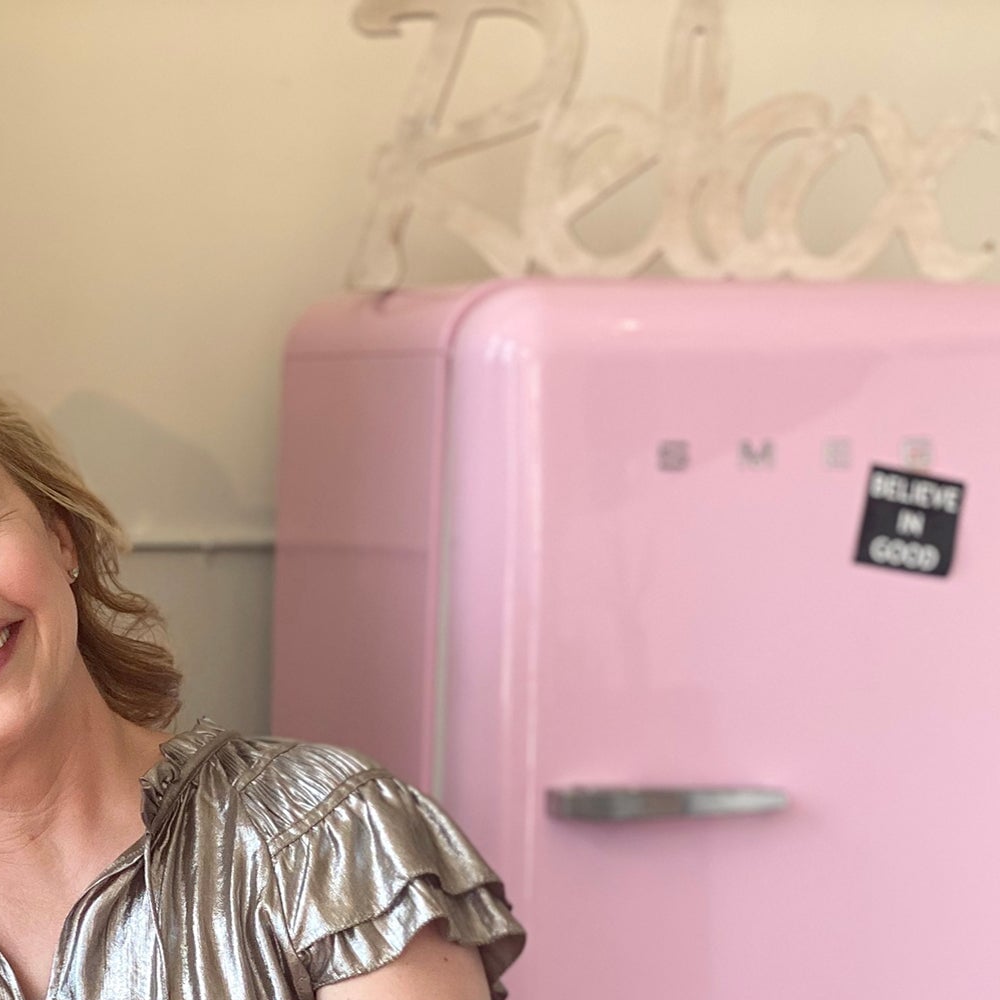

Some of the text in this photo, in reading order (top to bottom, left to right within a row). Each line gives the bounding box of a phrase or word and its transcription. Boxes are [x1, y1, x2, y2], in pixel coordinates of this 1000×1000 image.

[346, 0, 1000, 290] Relax
[869, 470, 961, 514] BELIEVE
[896, 507, 926, 539] IN
[868, 535, 940, 572] GOOD
